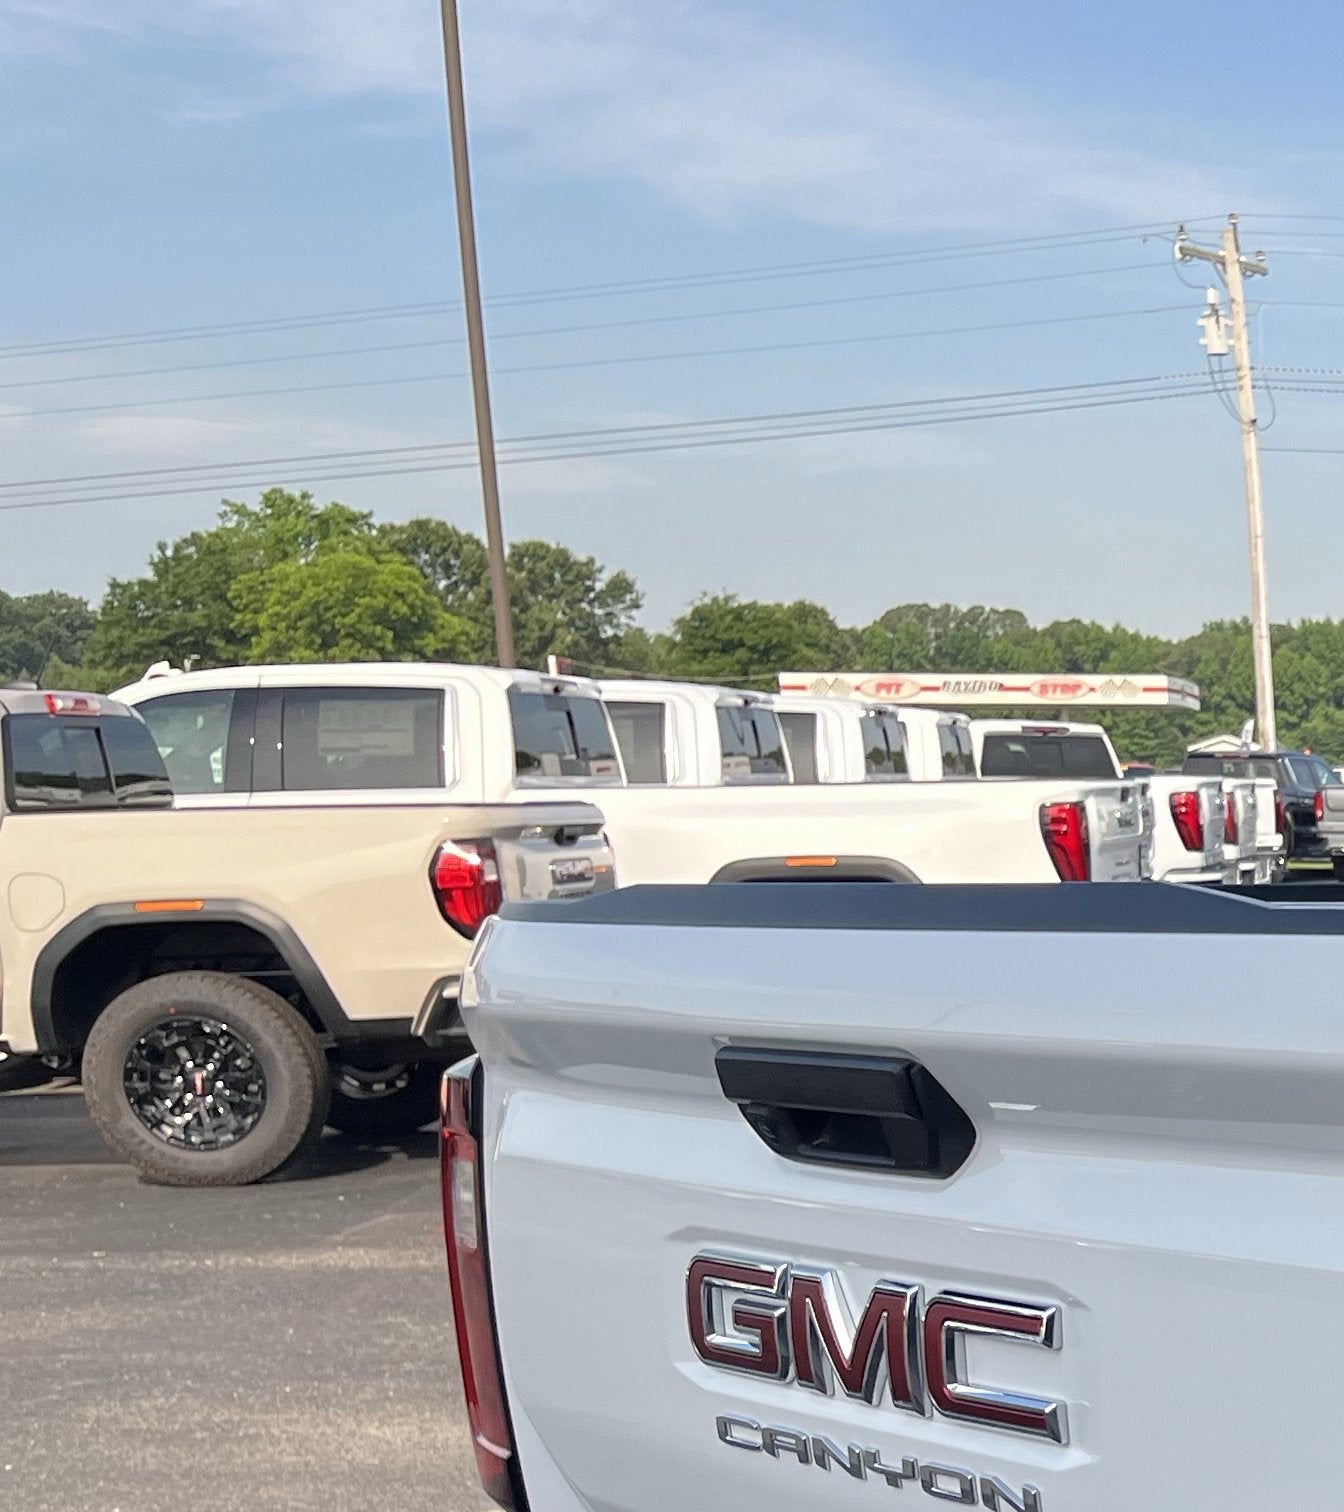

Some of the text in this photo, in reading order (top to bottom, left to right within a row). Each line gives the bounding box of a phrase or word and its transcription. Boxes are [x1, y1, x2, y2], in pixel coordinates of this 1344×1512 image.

[875, 682, 903, 696] PIT
[1039, 682, 1082, 696] STOP
[686, 1249, 1071, 1446] GMC
